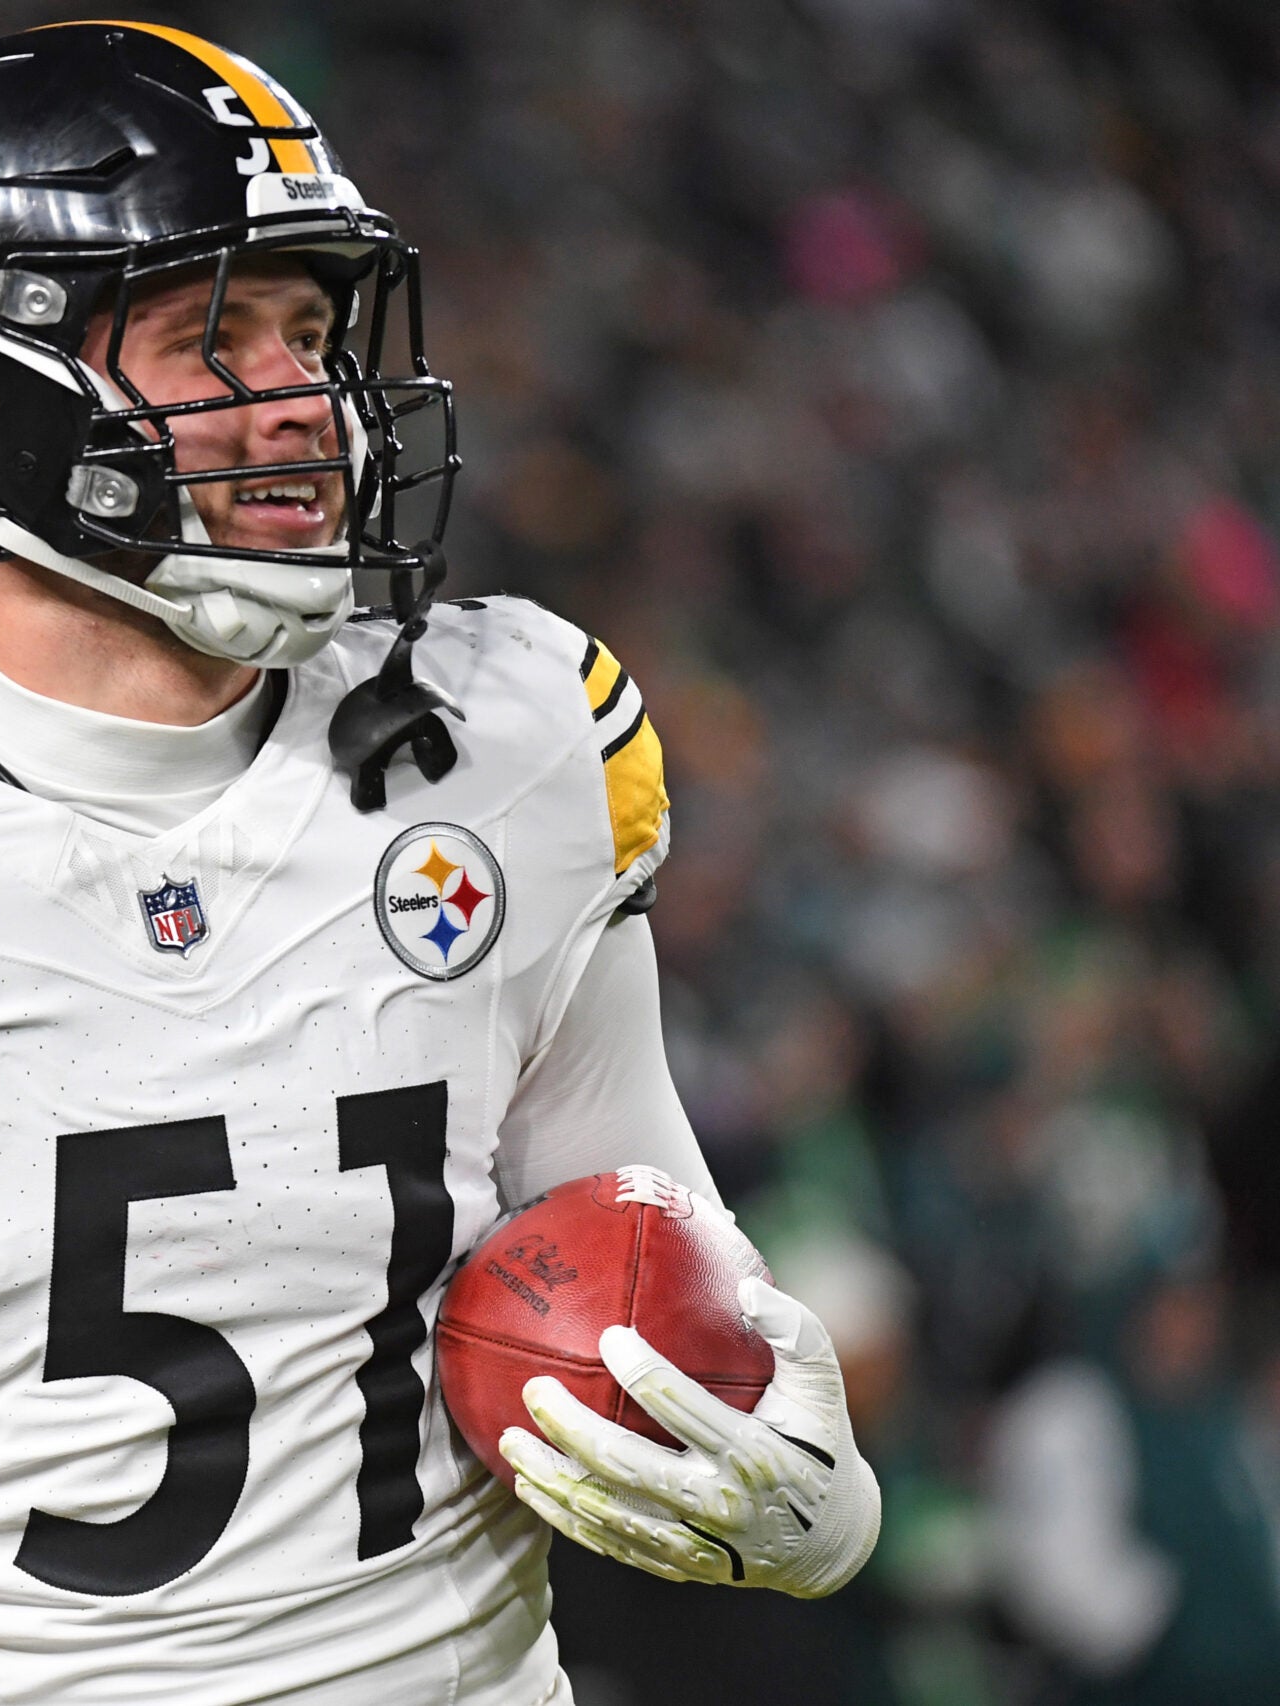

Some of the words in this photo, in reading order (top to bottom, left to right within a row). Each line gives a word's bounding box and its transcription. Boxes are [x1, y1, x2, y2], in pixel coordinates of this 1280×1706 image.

[388, 893, 439, 914] Steelers
[154, 908, 196, 943] NFL
[13, 1080, 455, 1598] 51
